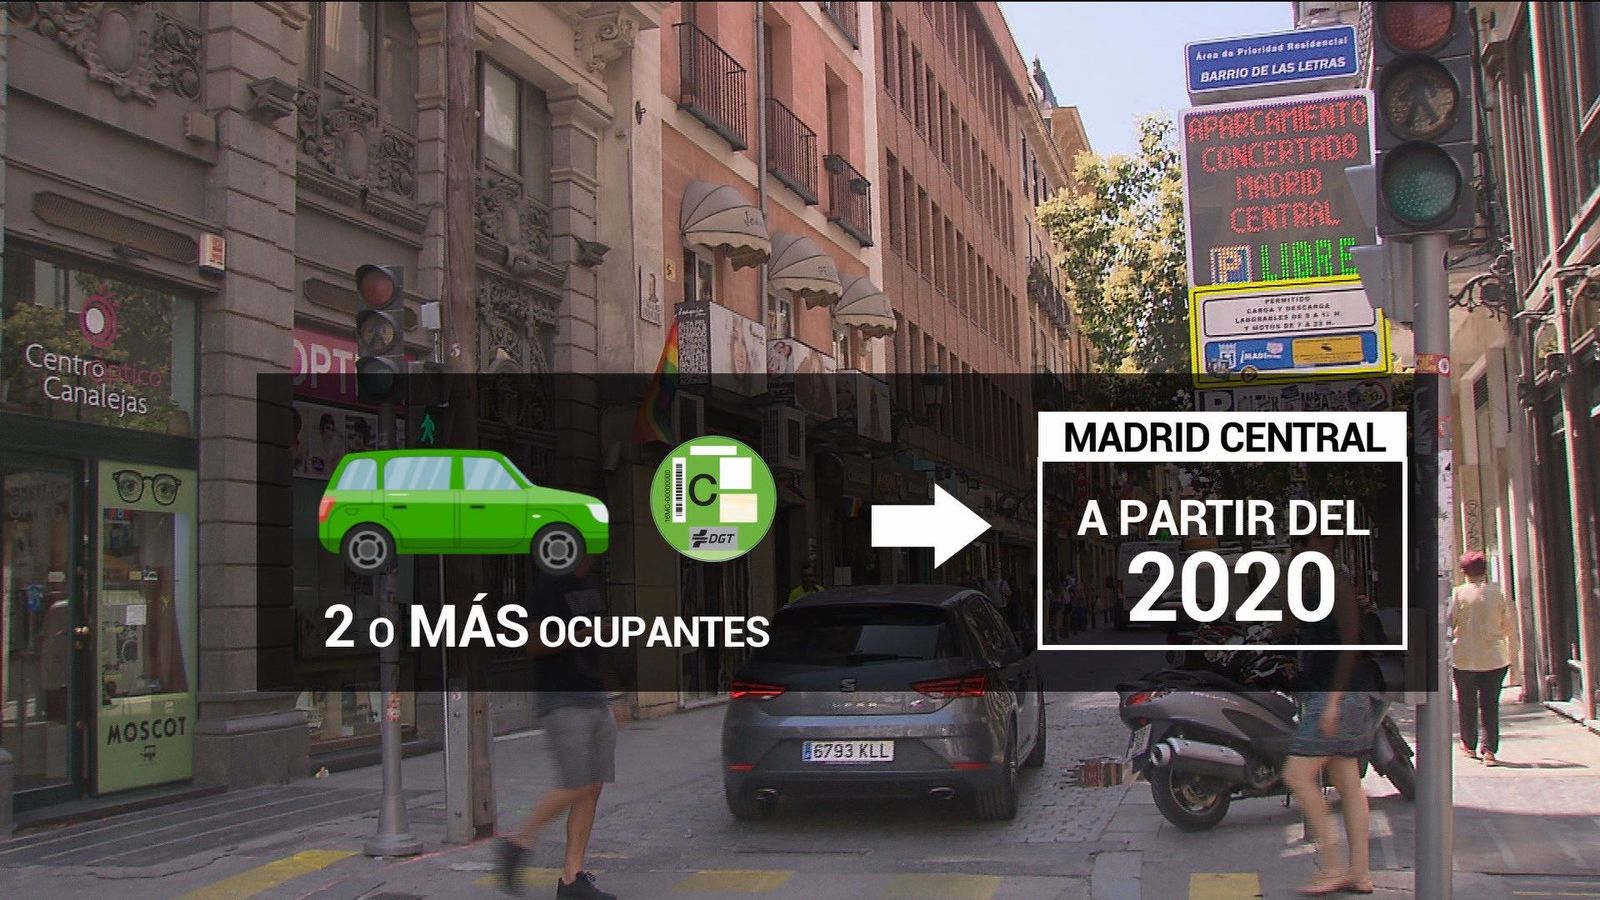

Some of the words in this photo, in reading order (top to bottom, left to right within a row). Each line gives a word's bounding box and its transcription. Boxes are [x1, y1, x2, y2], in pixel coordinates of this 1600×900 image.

[1221, 48, 1234, 58] de
[1237, 43, 1284, 56] Prioridad
[1287, 36, 1348, 51] Residencial
[1200, 67, 1249, 83] BARRIO
[1251, 64, 1268, 77] DE
[1271, 62, 1295, 75] LAS
[1298, 56, 1347, 71] LETRAS
[1188, 101, 1367, 143] APARCAMIENTO
[1201, 132, 1359, 173] CONCERTADO
[1234, 167, 1324, 201] MADRID
[1229, 199, 1341, 234] CENTRAL
[1260, 236, 1358, 282] LIBRE
[1246, 307, 1275, 315] CARGA
[1285, 303, 1331, 312] DESCARGA
[1264, 296, 1311, 304] PERMITIDO
[1234, 314, 1289, 324] LABORABLES
[1252, 323, 1282, 331] MOTOS
[25, 343, 105, 378] Centro
[44, 376, 148, 417] Canalejas
[107, 716, 187, 745] MOSCOT
[813, 743, 854, 759] 6793
[859, 743, 889, 759] KLL
